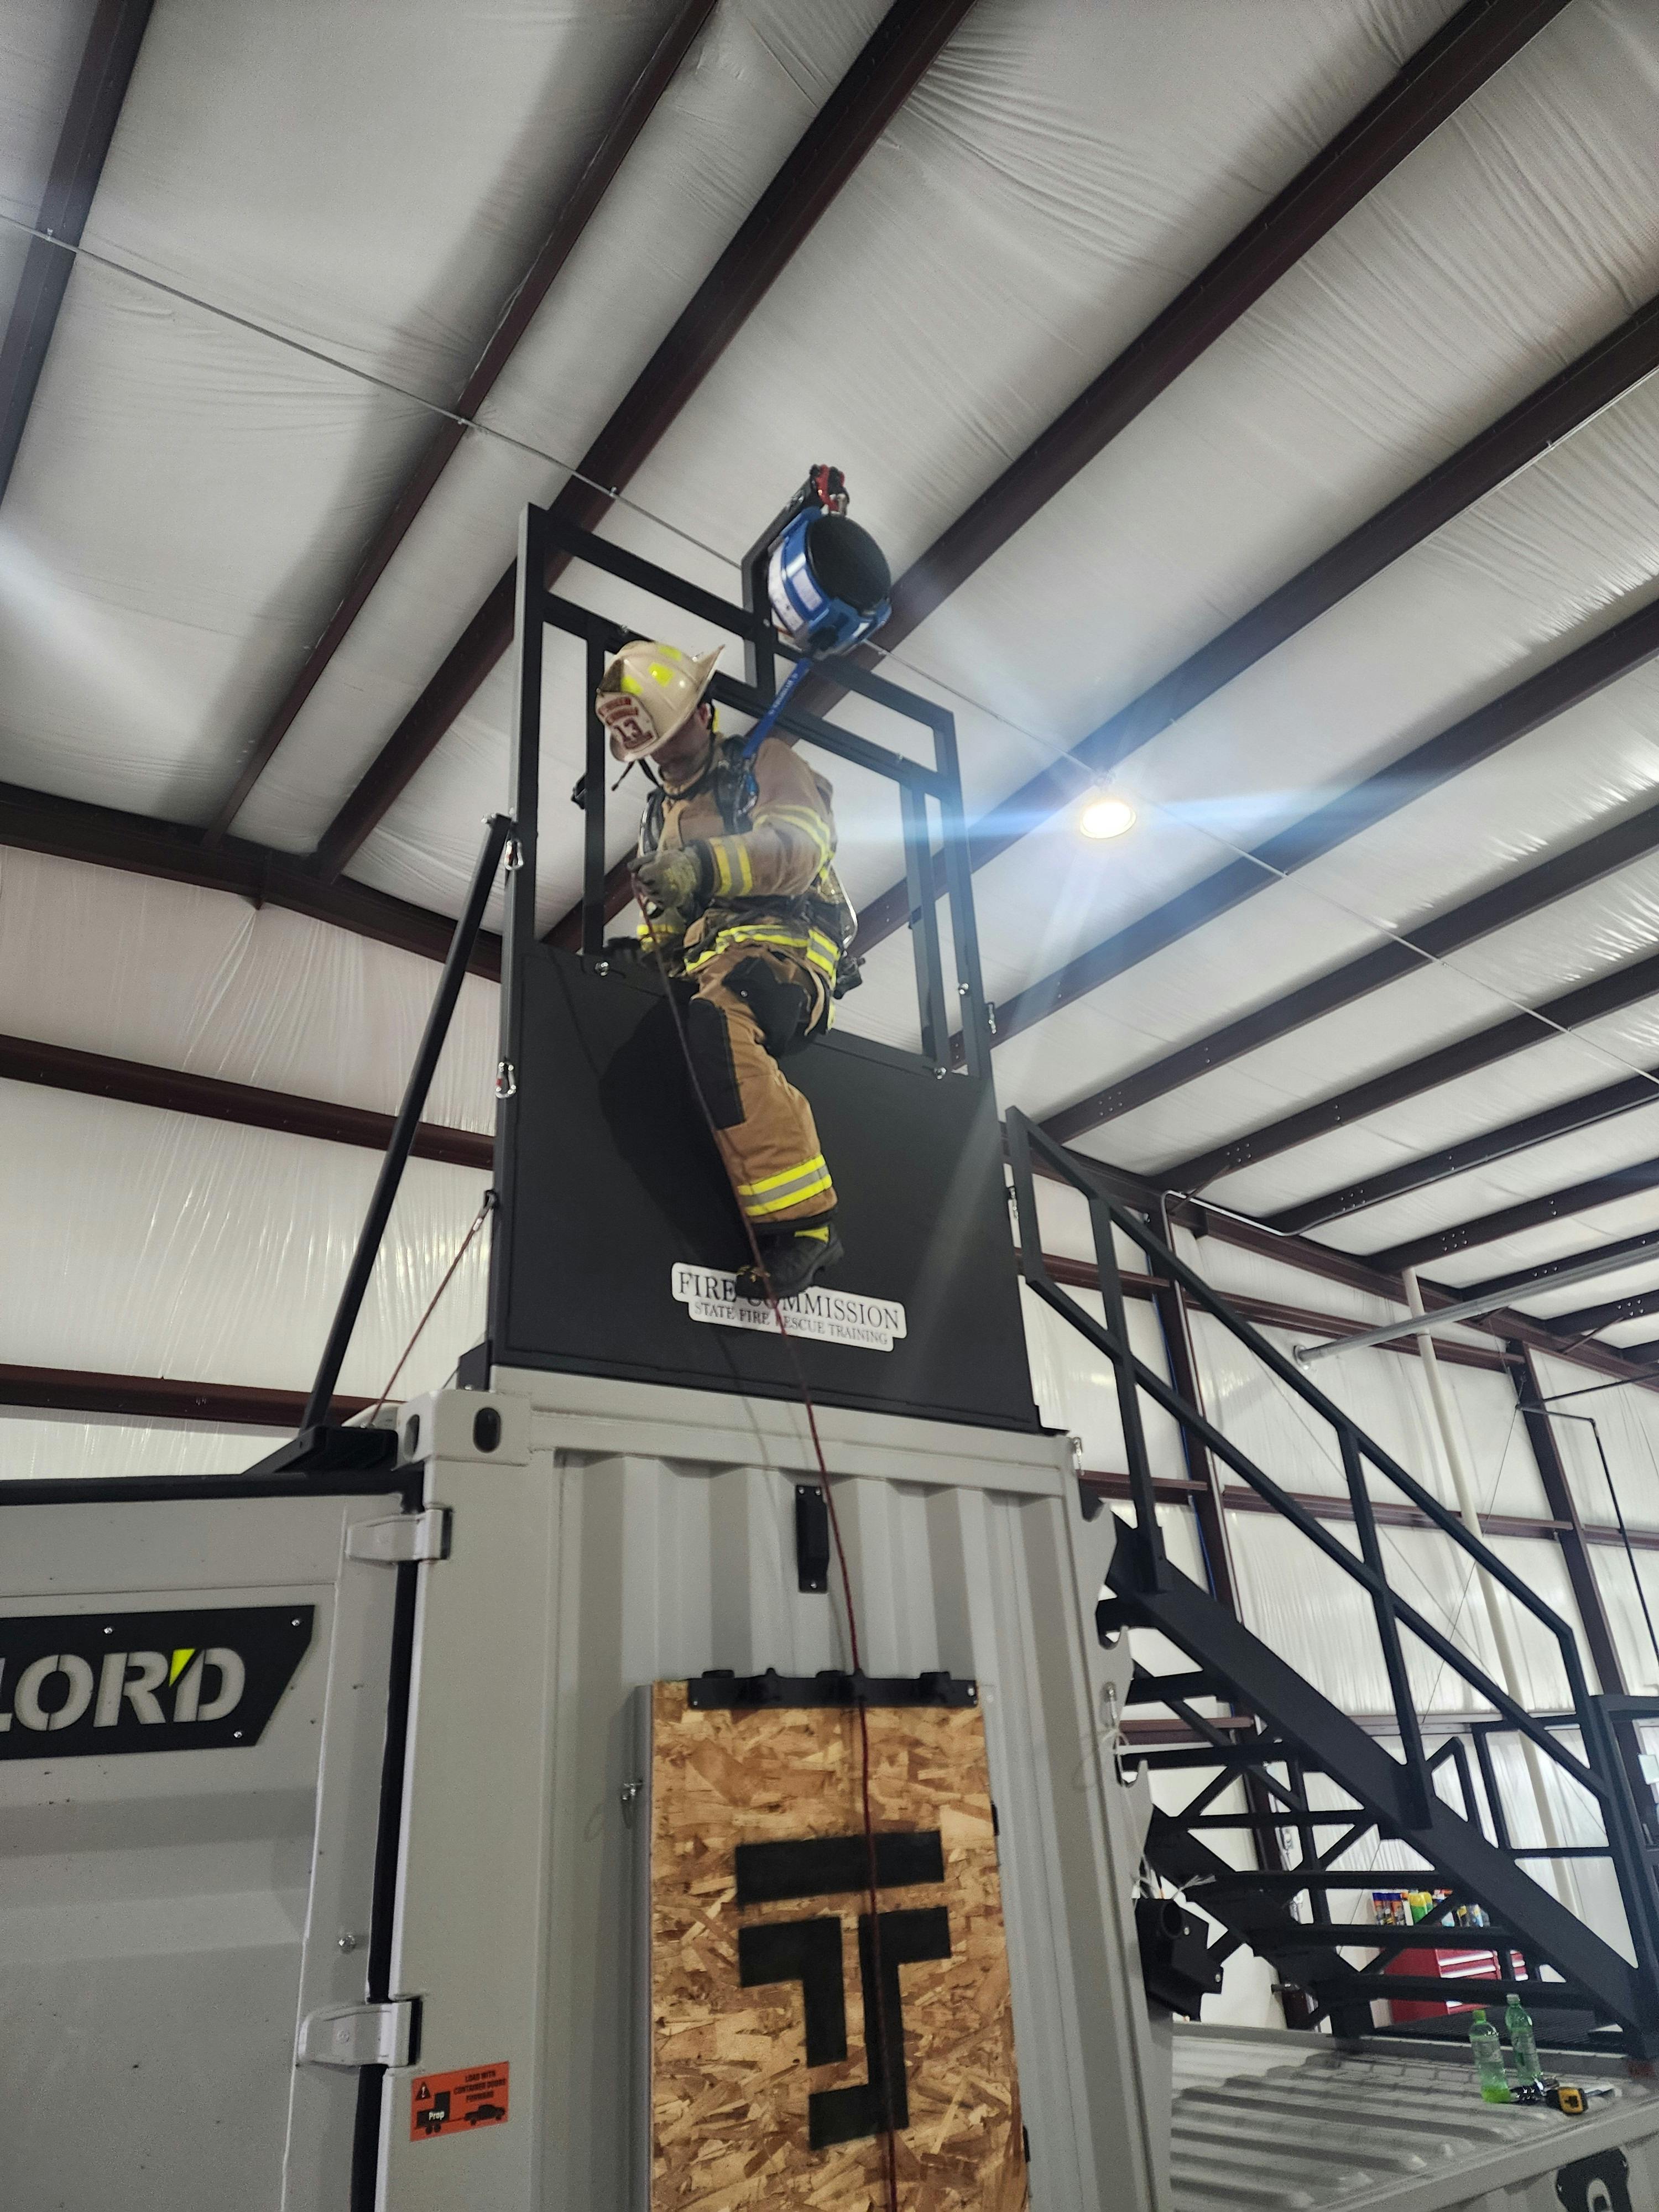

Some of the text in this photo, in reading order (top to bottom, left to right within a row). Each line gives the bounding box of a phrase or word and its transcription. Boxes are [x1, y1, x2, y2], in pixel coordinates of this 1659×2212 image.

[614, 718, 643, 743] 13
[679, 1271, 899, 1330] FIRE MMISSION
[695, 1302, 734, 1321] STATE
[739, 1309, 770, 1326] FIRE
[830, 1324, 888, 1345] TRAINING
[429, 2110, 445, 2120] Prop
